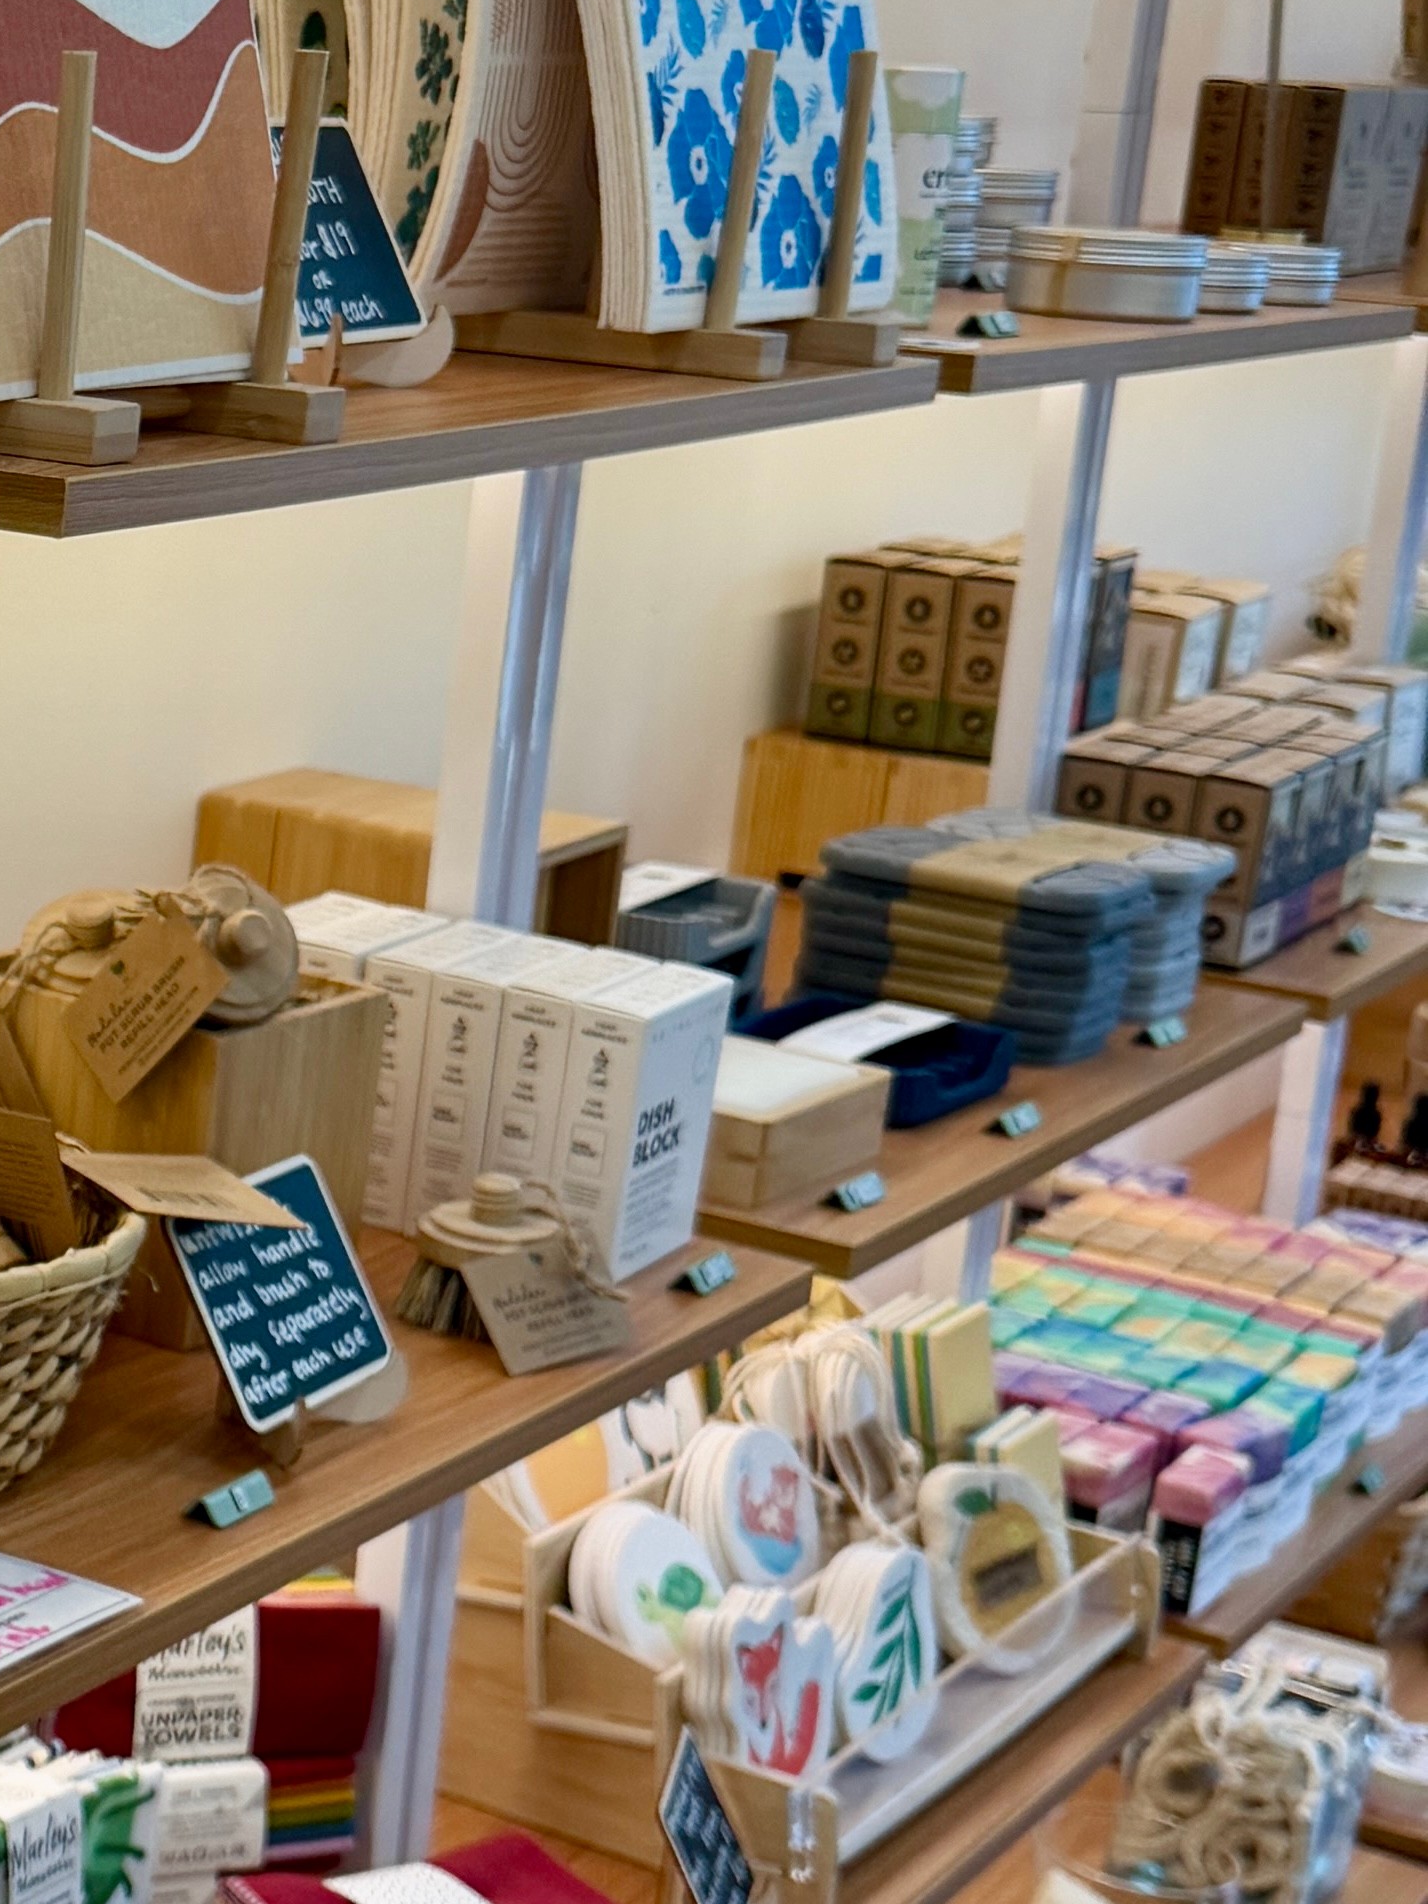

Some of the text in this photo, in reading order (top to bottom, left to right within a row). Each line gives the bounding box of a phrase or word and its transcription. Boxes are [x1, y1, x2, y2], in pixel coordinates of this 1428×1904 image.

[340, 293, 385, 325] each
[637, 1098, 677, 1137] DISH
[630, 1126, 682, 1168] BLOCK
[197, 1221, 324, 1292] allow handle
[211, 1289, 259, 1332] and
[267, 1284, 373, 1347] separately
[242, 1324, 373, 1406] after each use
[141, 1706, 241, 1729] UNPAPER
[144, 1721, 242, 1747] TOWELS
[8, 1806, 79, 1878] Marley's
